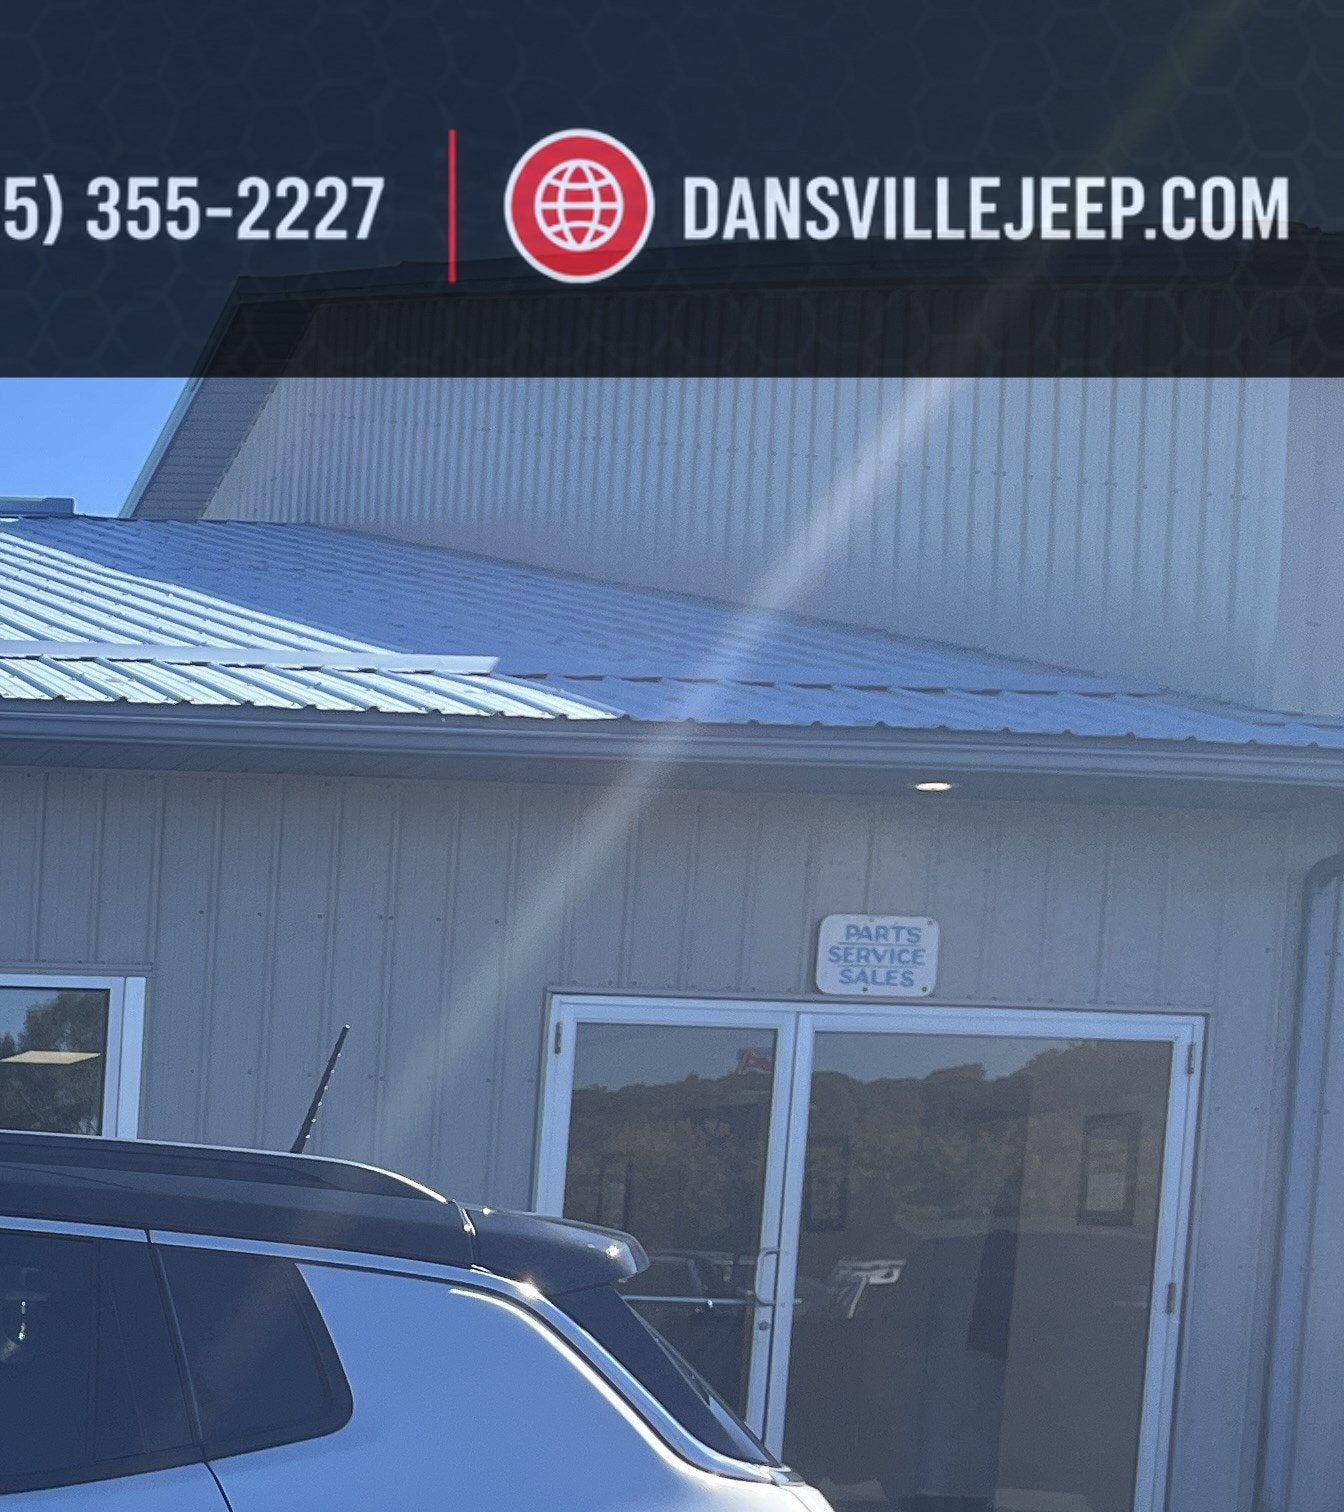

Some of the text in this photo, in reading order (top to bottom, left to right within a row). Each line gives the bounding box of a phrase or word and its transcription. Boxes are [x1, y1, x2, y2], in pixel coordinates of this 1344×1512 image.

[845, 924, 922, 944] PARTS
[828, 946, 926, 966] SERVICE
[839, 968, 915, 987] SALES
